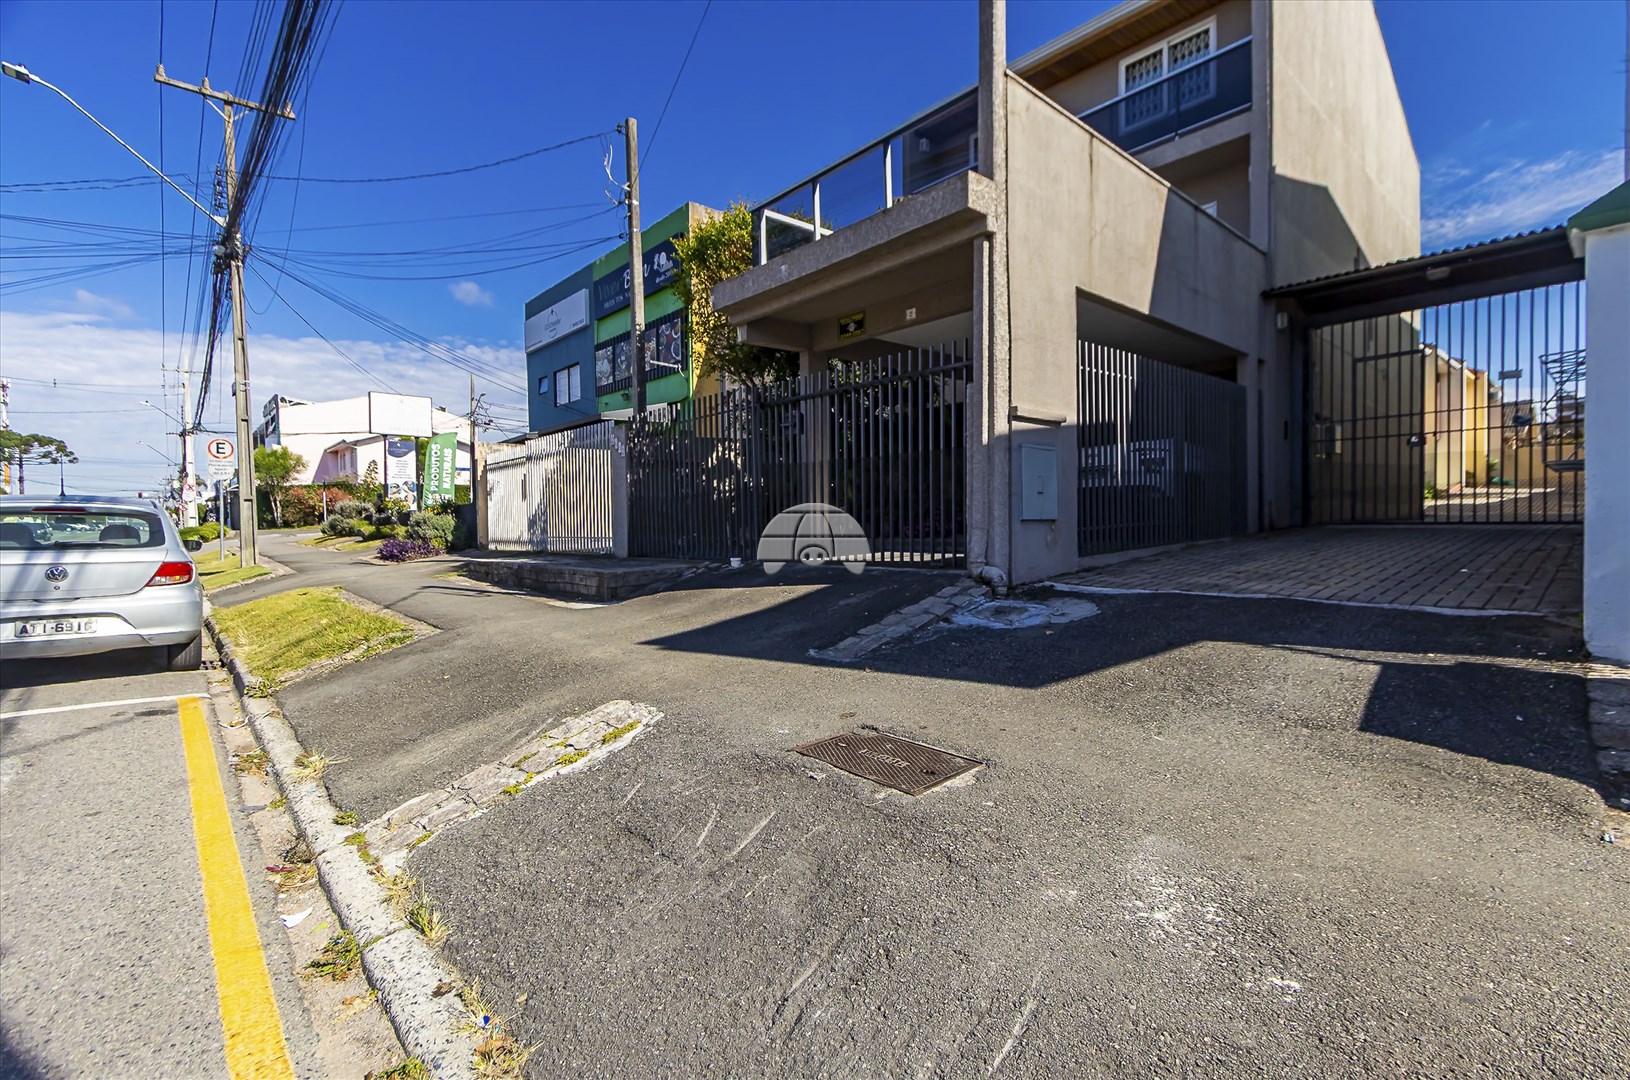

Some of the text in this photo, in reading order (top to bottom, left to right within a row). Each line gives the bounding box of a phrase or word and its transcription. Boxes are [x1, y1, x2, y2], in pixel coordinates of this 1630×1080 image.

[216, 442, 226, 455] E
[430, 443, 441, 491] PRODUTOS
[442, 447, 453, 489] NATURAIS
